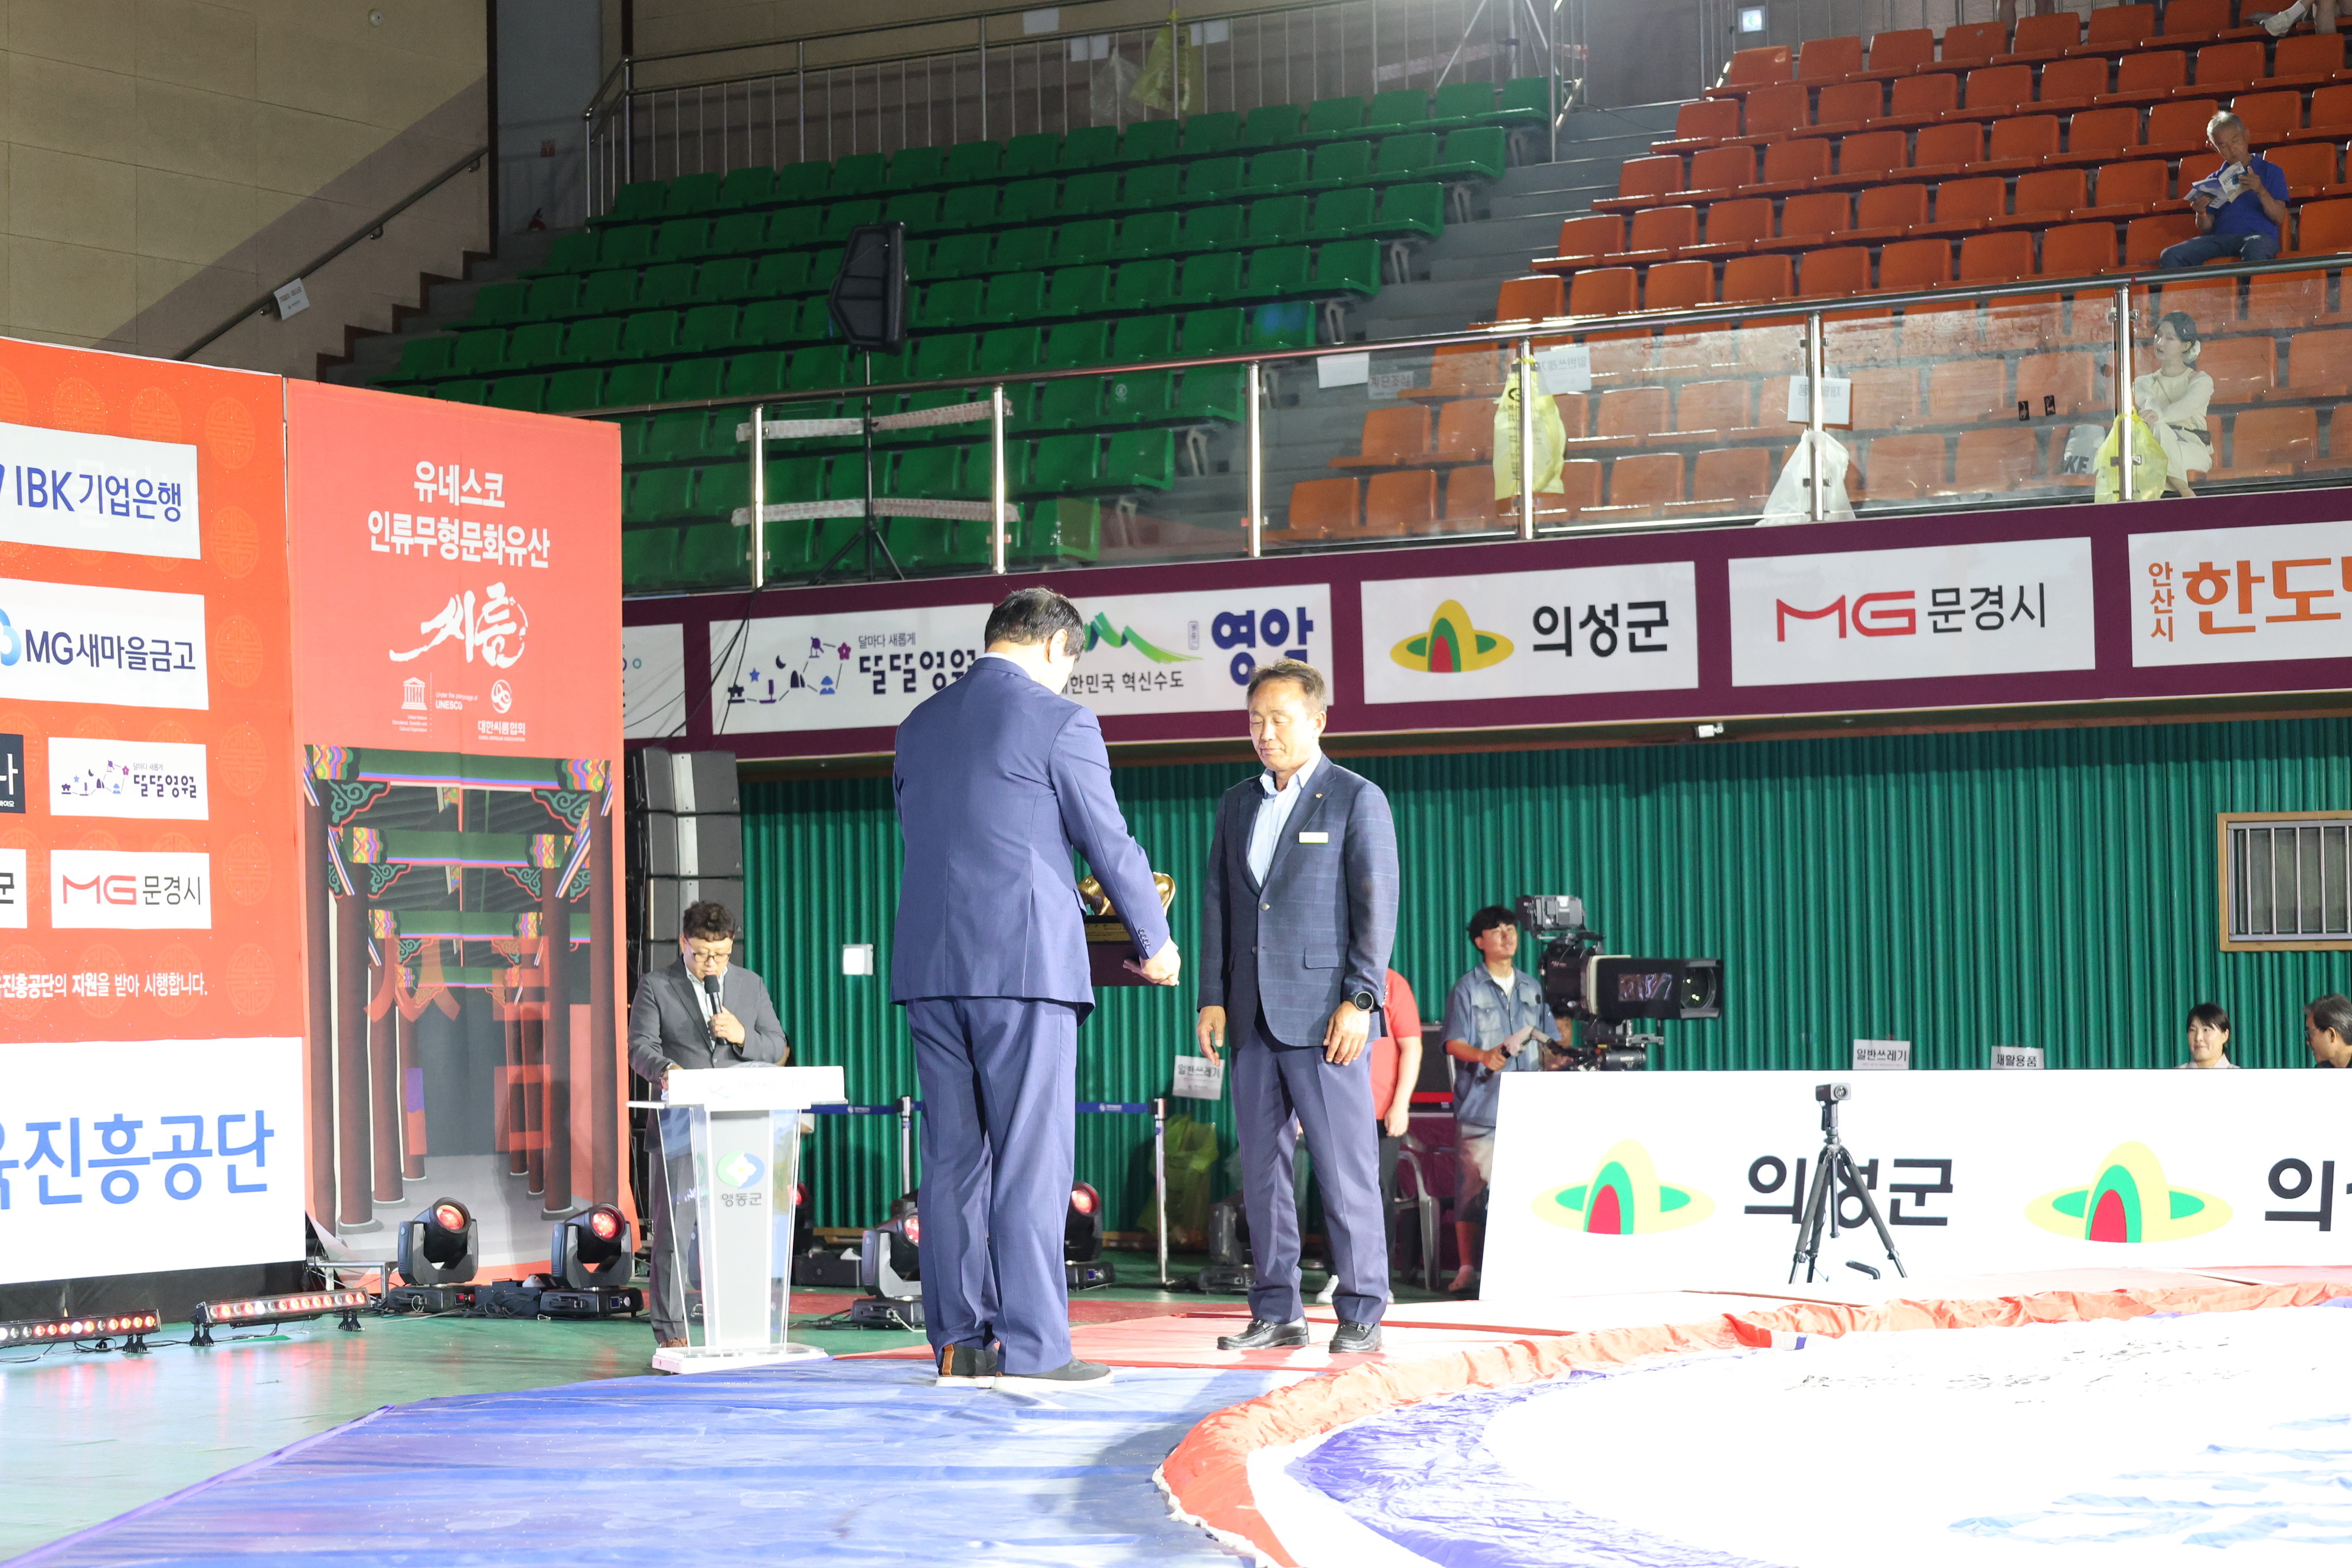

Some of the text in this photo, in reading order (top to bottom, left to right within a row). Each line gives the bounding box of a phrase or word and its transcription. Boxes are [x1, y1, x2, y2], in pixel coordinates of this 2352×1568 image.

[16, 465, 181, 522] IBK기업은행
[414, 460, 505, 508] 유네스코
[368, 510, 550, 568] 인류무형문화유산
[1776, 590, 1916, 642] MG
[1928, 582, 2046, 634] 문경시
[2148, 561, 2174, 642] 안산시
[2183, 556, 2352, 635] 한도
[389, 582, 528, 668] 씨름
[858, 632, 916, 649] 달마다 새롭게
[1533, 600, 1669, 657] 의성군
[25, 629, 195, 672] MG새마을금고
[1063, 671, 1184, 695] 한민국 혁신수도
[435, 700, 463, 710] UNESCO
[478, 720, 525, 736] 대한씨름협회
[134, 775, 197, 799] 달달영월
[63, 874, 136, 905] MG
[142, 876, 201, 905] 문경시
[0, 972, 207, 998] 진흥공단의 지원을 받아 시행합니다.
[1857, 1048, 1906, 1061] 일반쓰레기
[1997, 1053, 2037, 1067] 재활용품
[0, 1110, 275, 1210] 진흥공단
[722, 1193, 762, 1207] 영동군
[2265, 1158, 2352, 1231] 의
